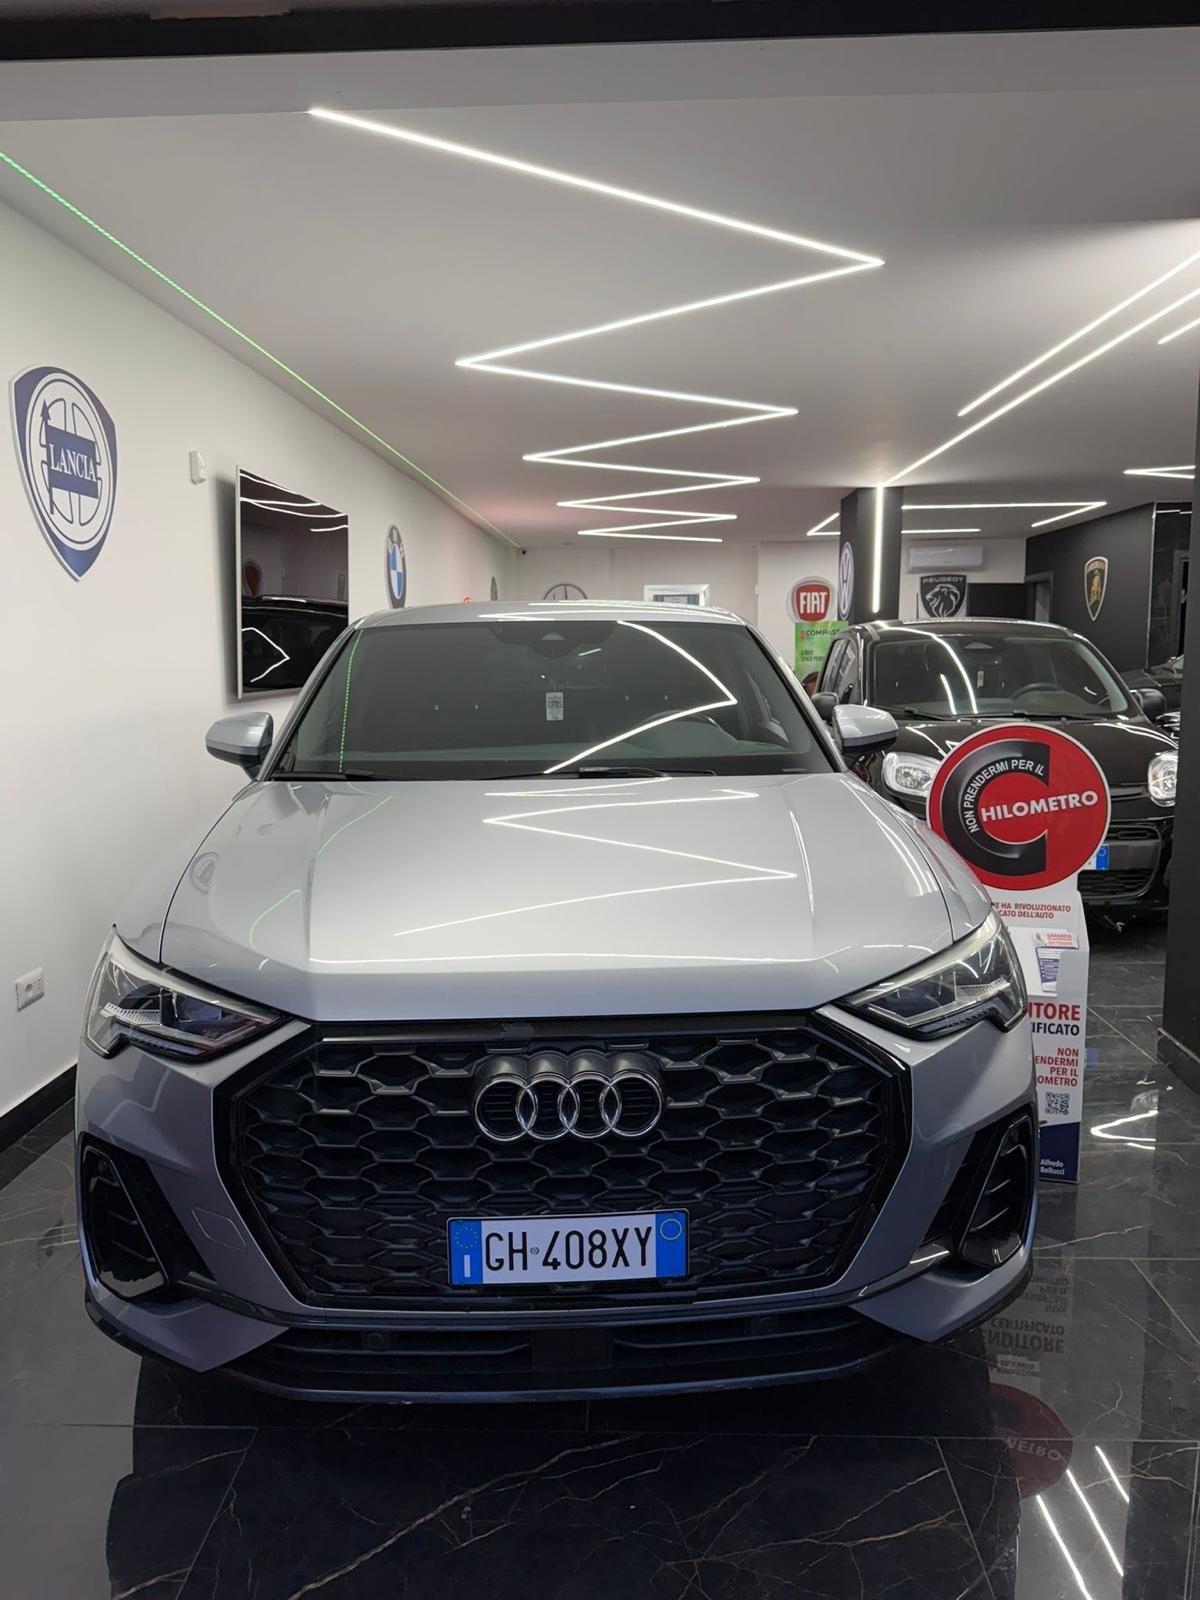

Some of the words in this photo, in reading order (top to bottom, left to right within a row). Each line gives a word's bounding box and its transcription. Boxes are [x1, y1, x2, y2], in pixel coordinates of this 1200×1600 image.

[49, 443, 97, 482] LANCIA
[922, 576, 964, 584] PEUGEOT
[799, 591, 828, 614] FIAT
[1011, 759, 1034, 772] PER
[1035, 764, 1045, 776] IL
[963, 760, 1009, 808] PRENDERMI
[980, 790, 1098, 822] HILOMETRO
[964, 811, 980, 833] NON
[1014, 902, 1071, 913] RIVOLUZIONATO
[1018, 910, 1054, 919] DELL'AUTO
[1026, 1002, 1080, 1021] ITORE
[1031, 1021, 1080, 1036] IFICATO
[1057, 1047, 1079, 1057] NON
[1035, 1055, 1079, 1067] ENDERMI
[1050, 1066, 1067, 1077] PER
[1070, 1067, 1079, 1077] IL
[1037, 1075, 1078, 1087] OMETRO
